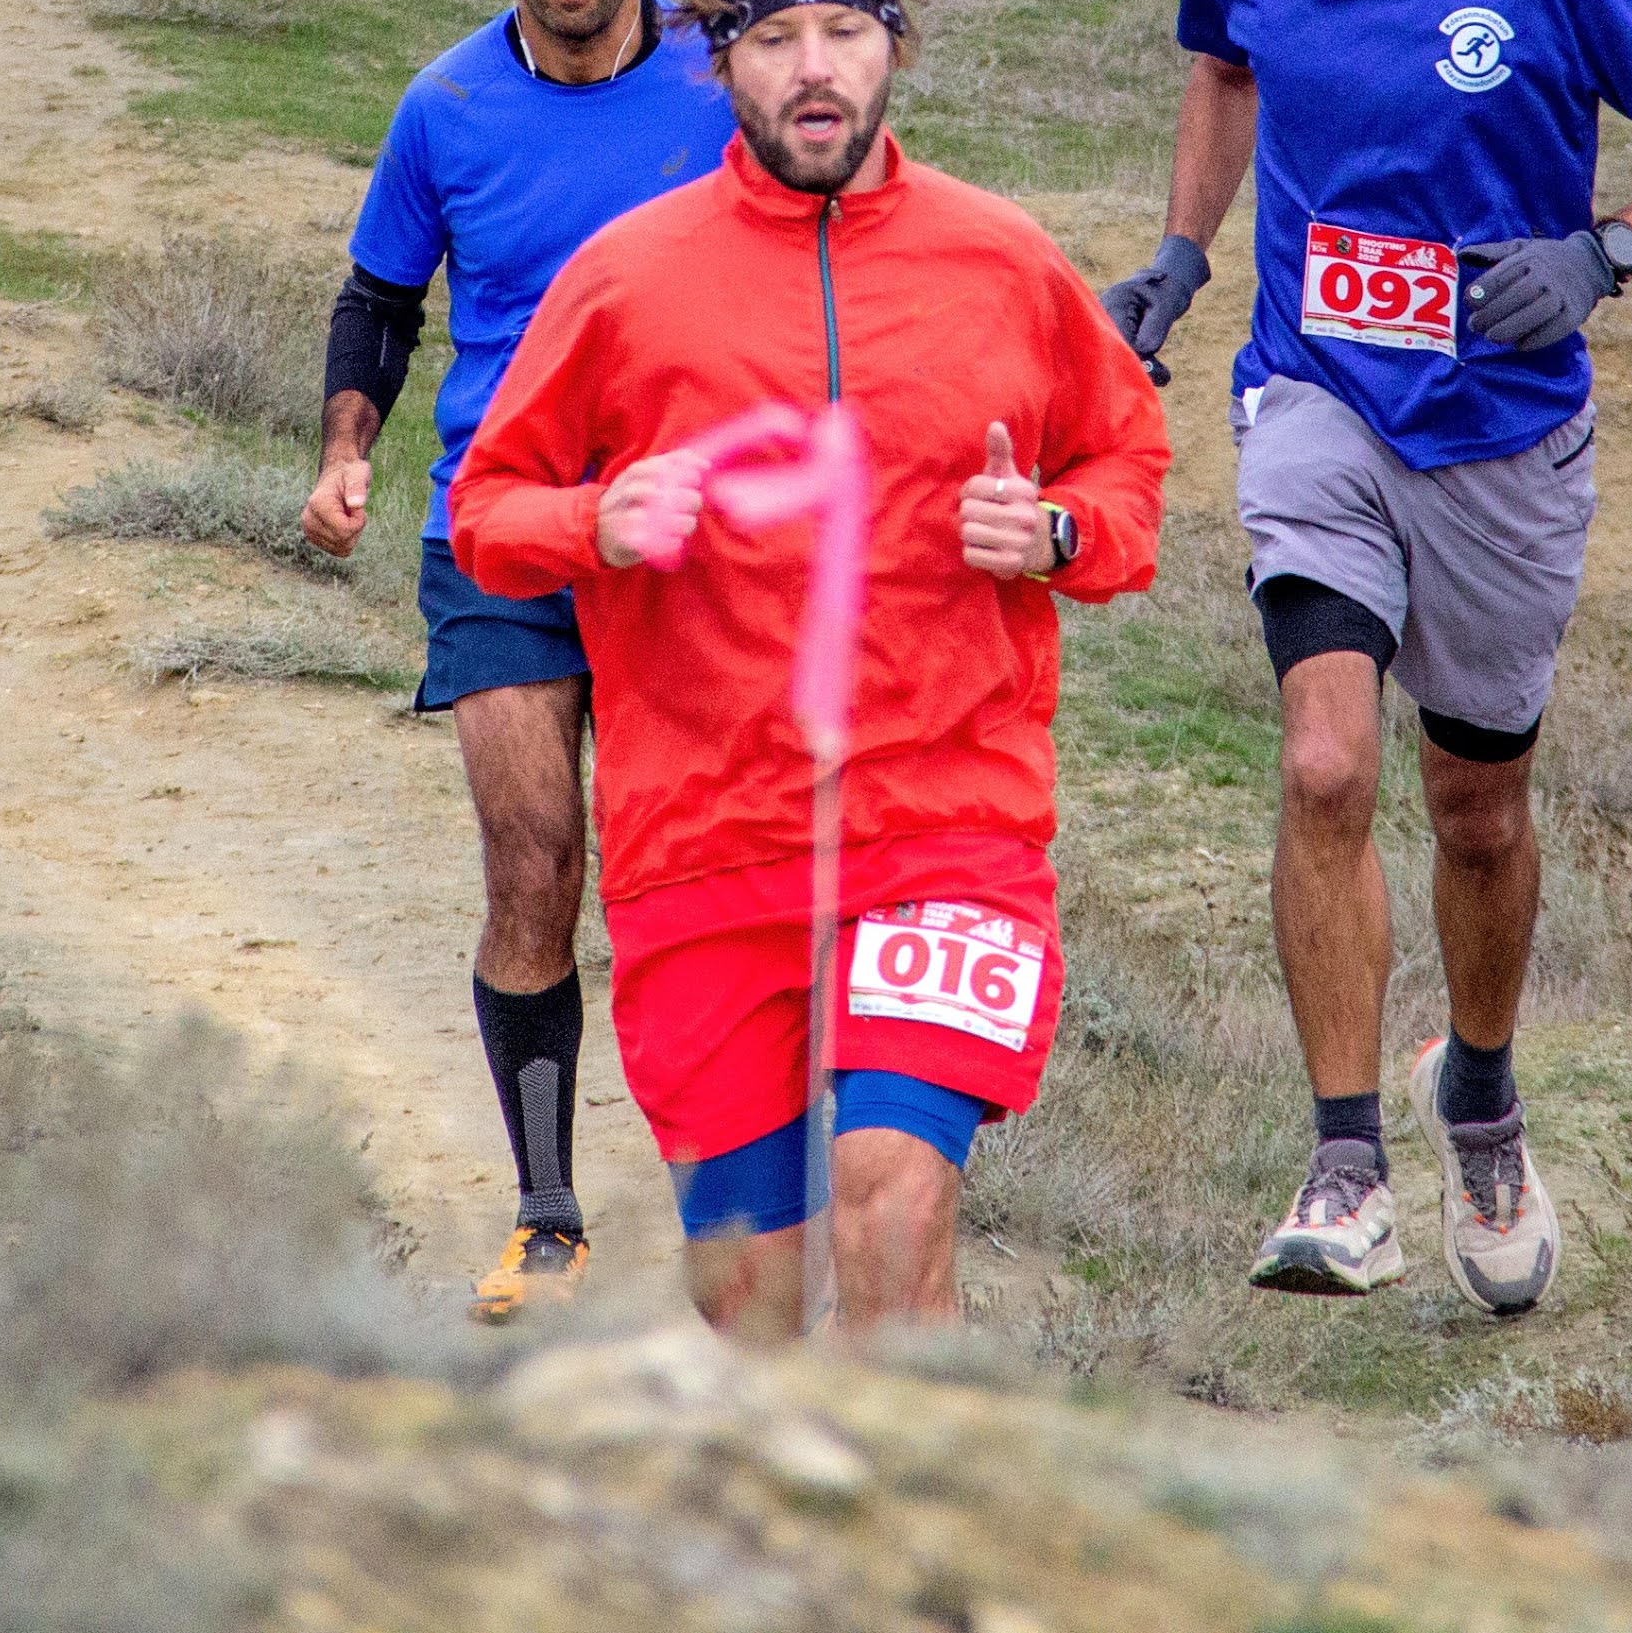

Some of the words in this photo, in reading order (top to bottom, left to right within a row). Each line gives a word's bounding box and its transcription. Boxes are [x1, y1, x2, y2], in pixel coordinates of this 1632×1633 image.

[1357, 237, 1407, 252] SHOOTING
[1320, 262, 1451, 328] 092
[877, 931, 1021, 1011] 016
